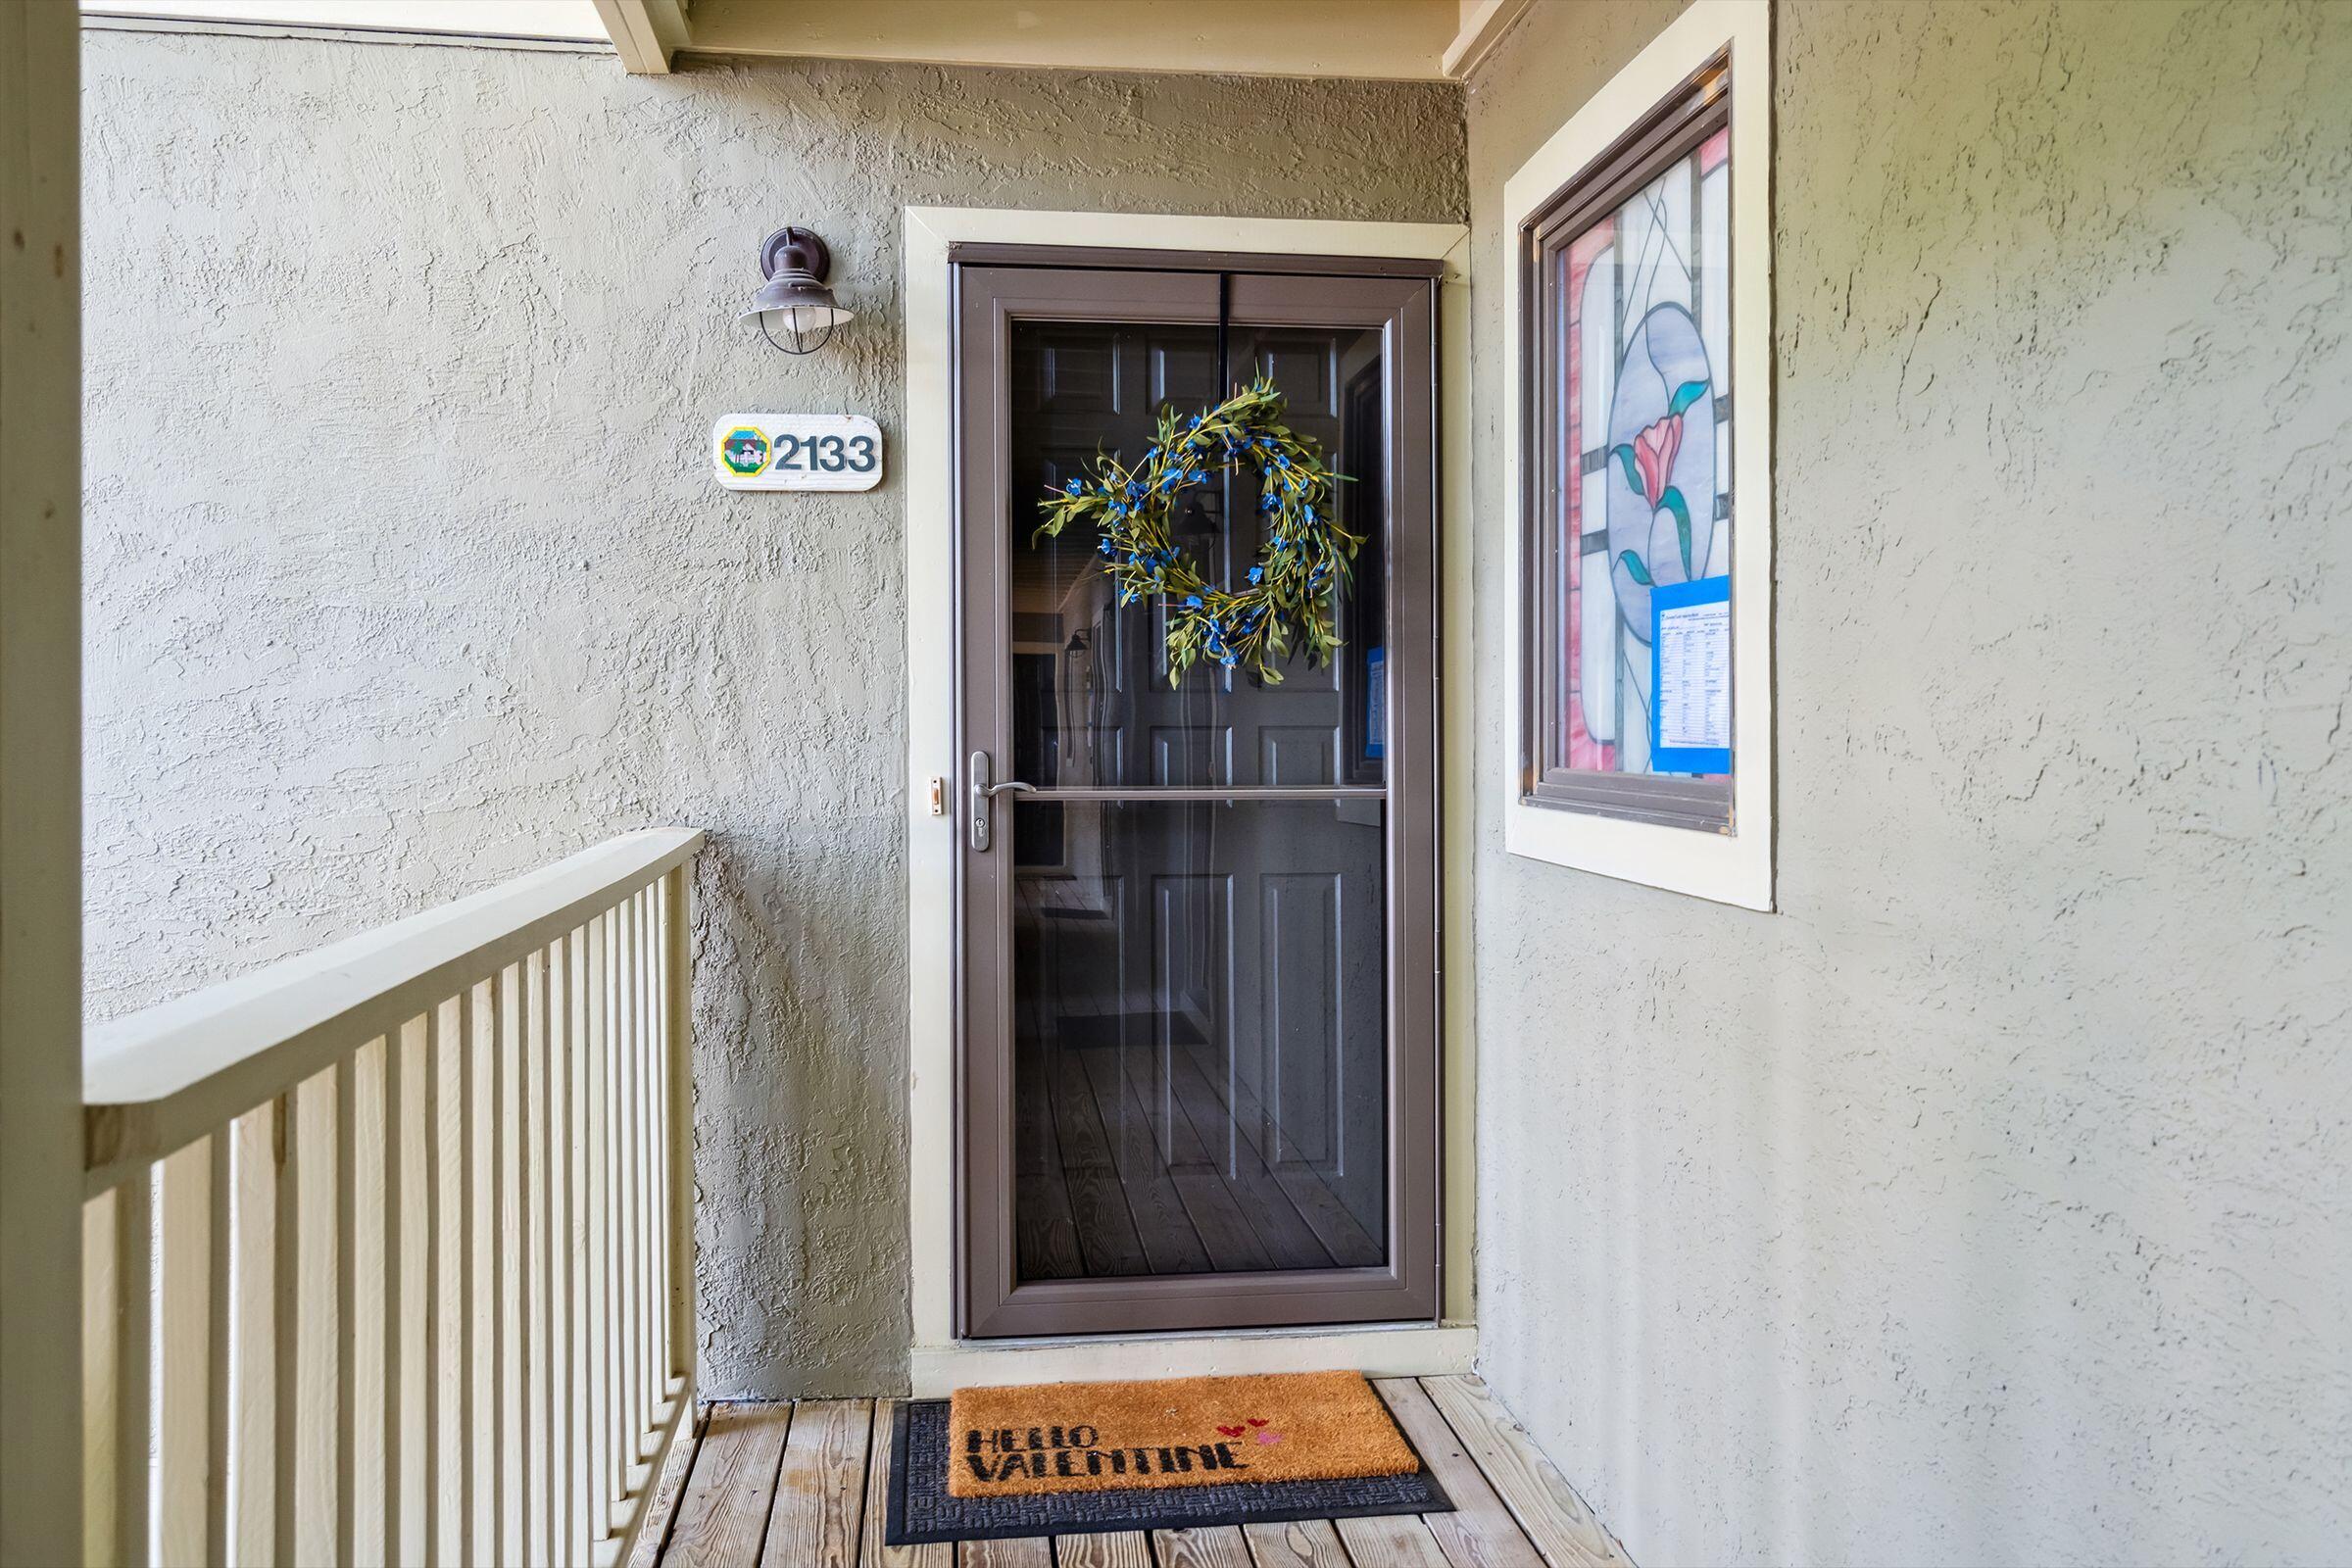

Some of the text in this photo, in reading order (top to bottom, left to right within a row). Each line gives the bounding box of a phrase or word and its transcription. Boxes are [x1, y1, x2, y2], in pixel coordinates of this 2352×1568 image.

[773, 434, 876, 472] 2133
[965, 1424, 1099, 1454] HELLO
[964, 1442, 1250, 1482] VALENTINE
